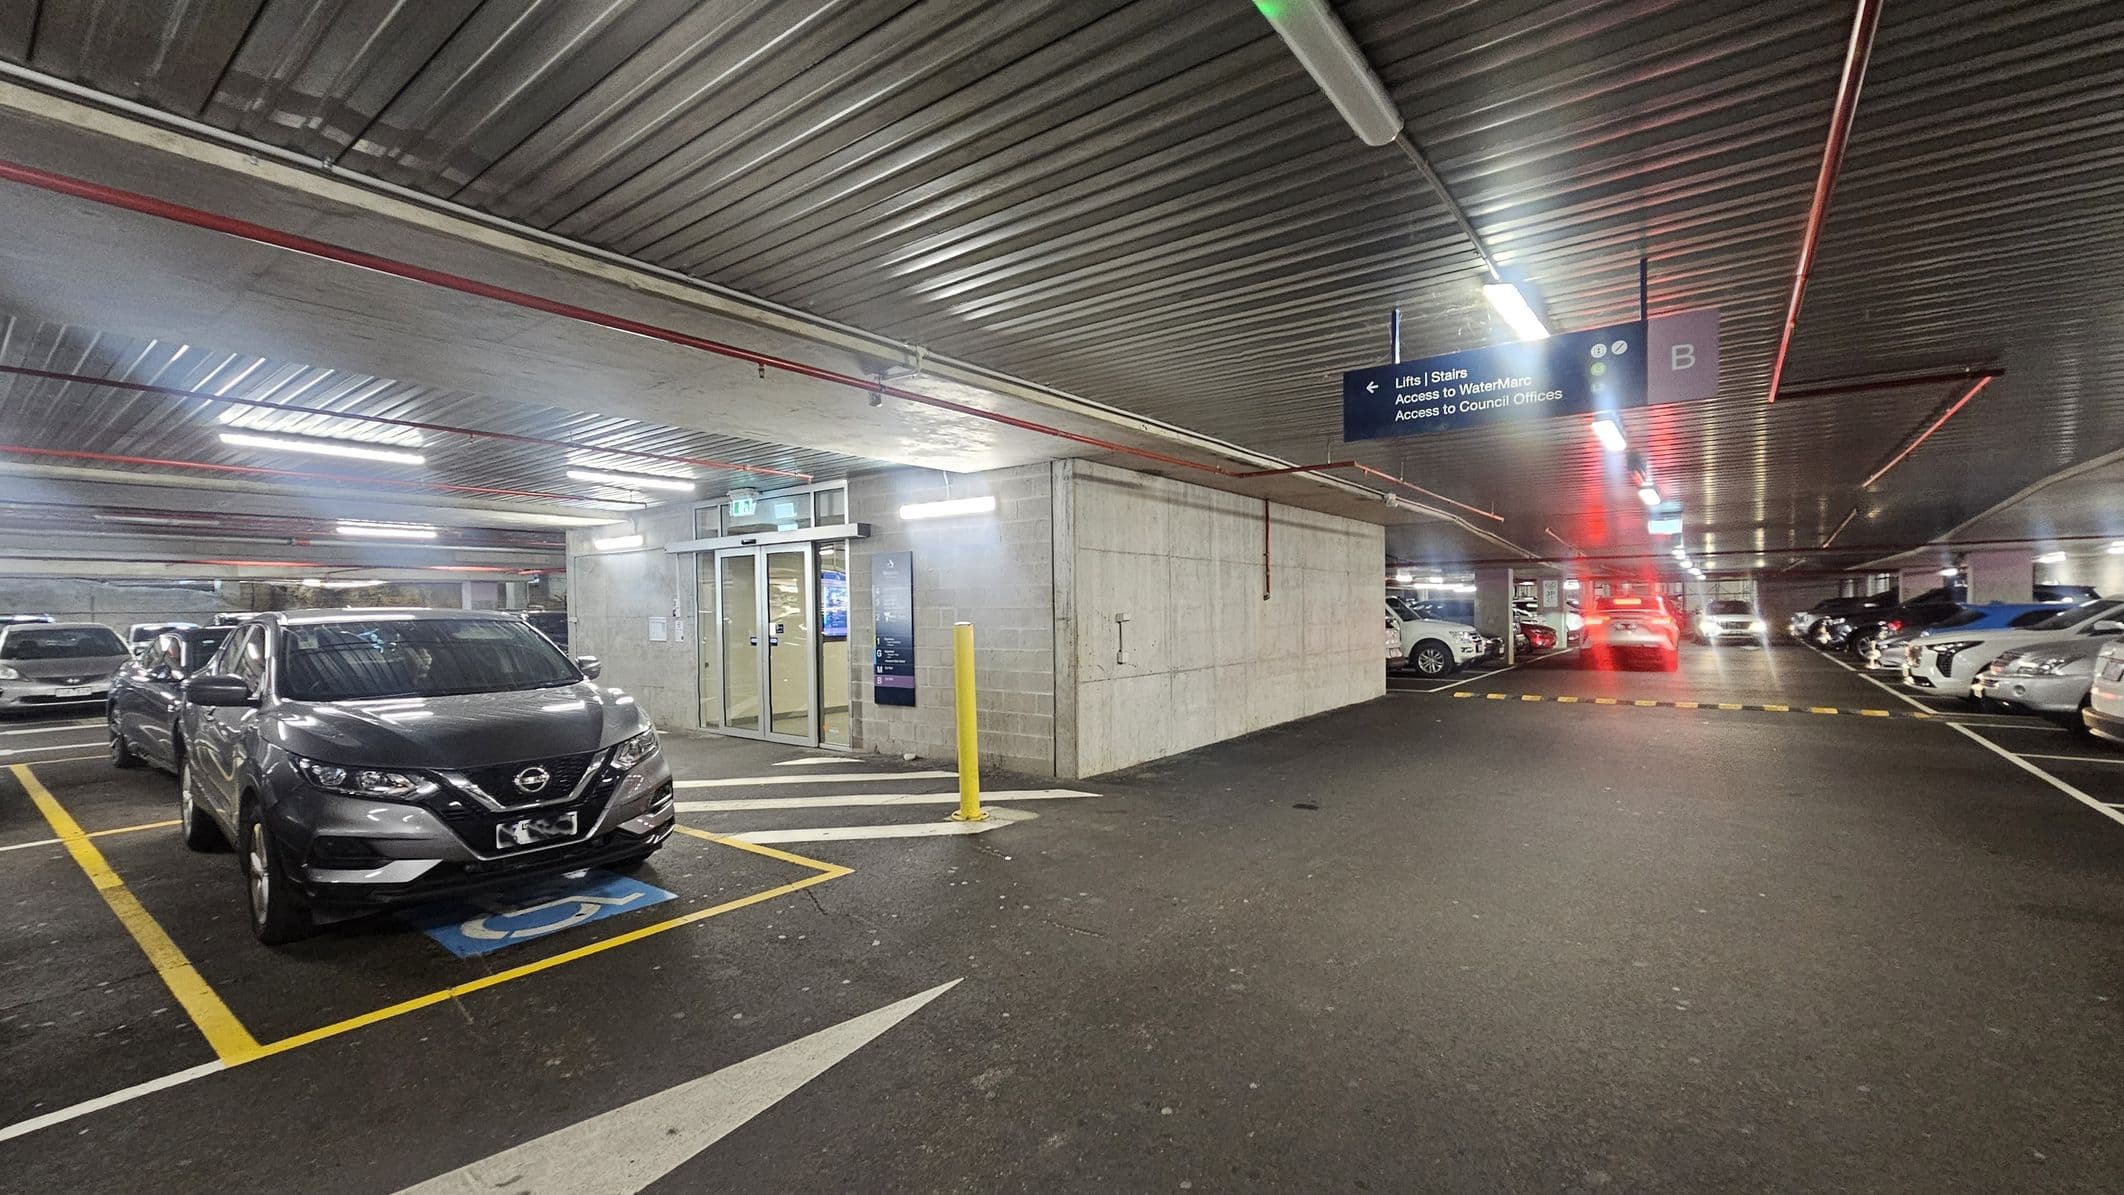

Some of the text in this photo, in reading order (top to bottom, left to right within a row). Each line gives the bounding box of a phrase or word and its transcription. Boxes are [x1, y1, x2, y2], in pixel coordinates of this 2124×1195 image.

[1672, 344, 1696, 370] B
[1395, 376, 1421, 389] Lifts
[1431, 368, 1468, 383] Stairs
[1395, 376, 1532, 405] Access to WaterMarc
[1395, 390, 1563, 422] Access to Council Offices
[877, 649, 882, 657] G
